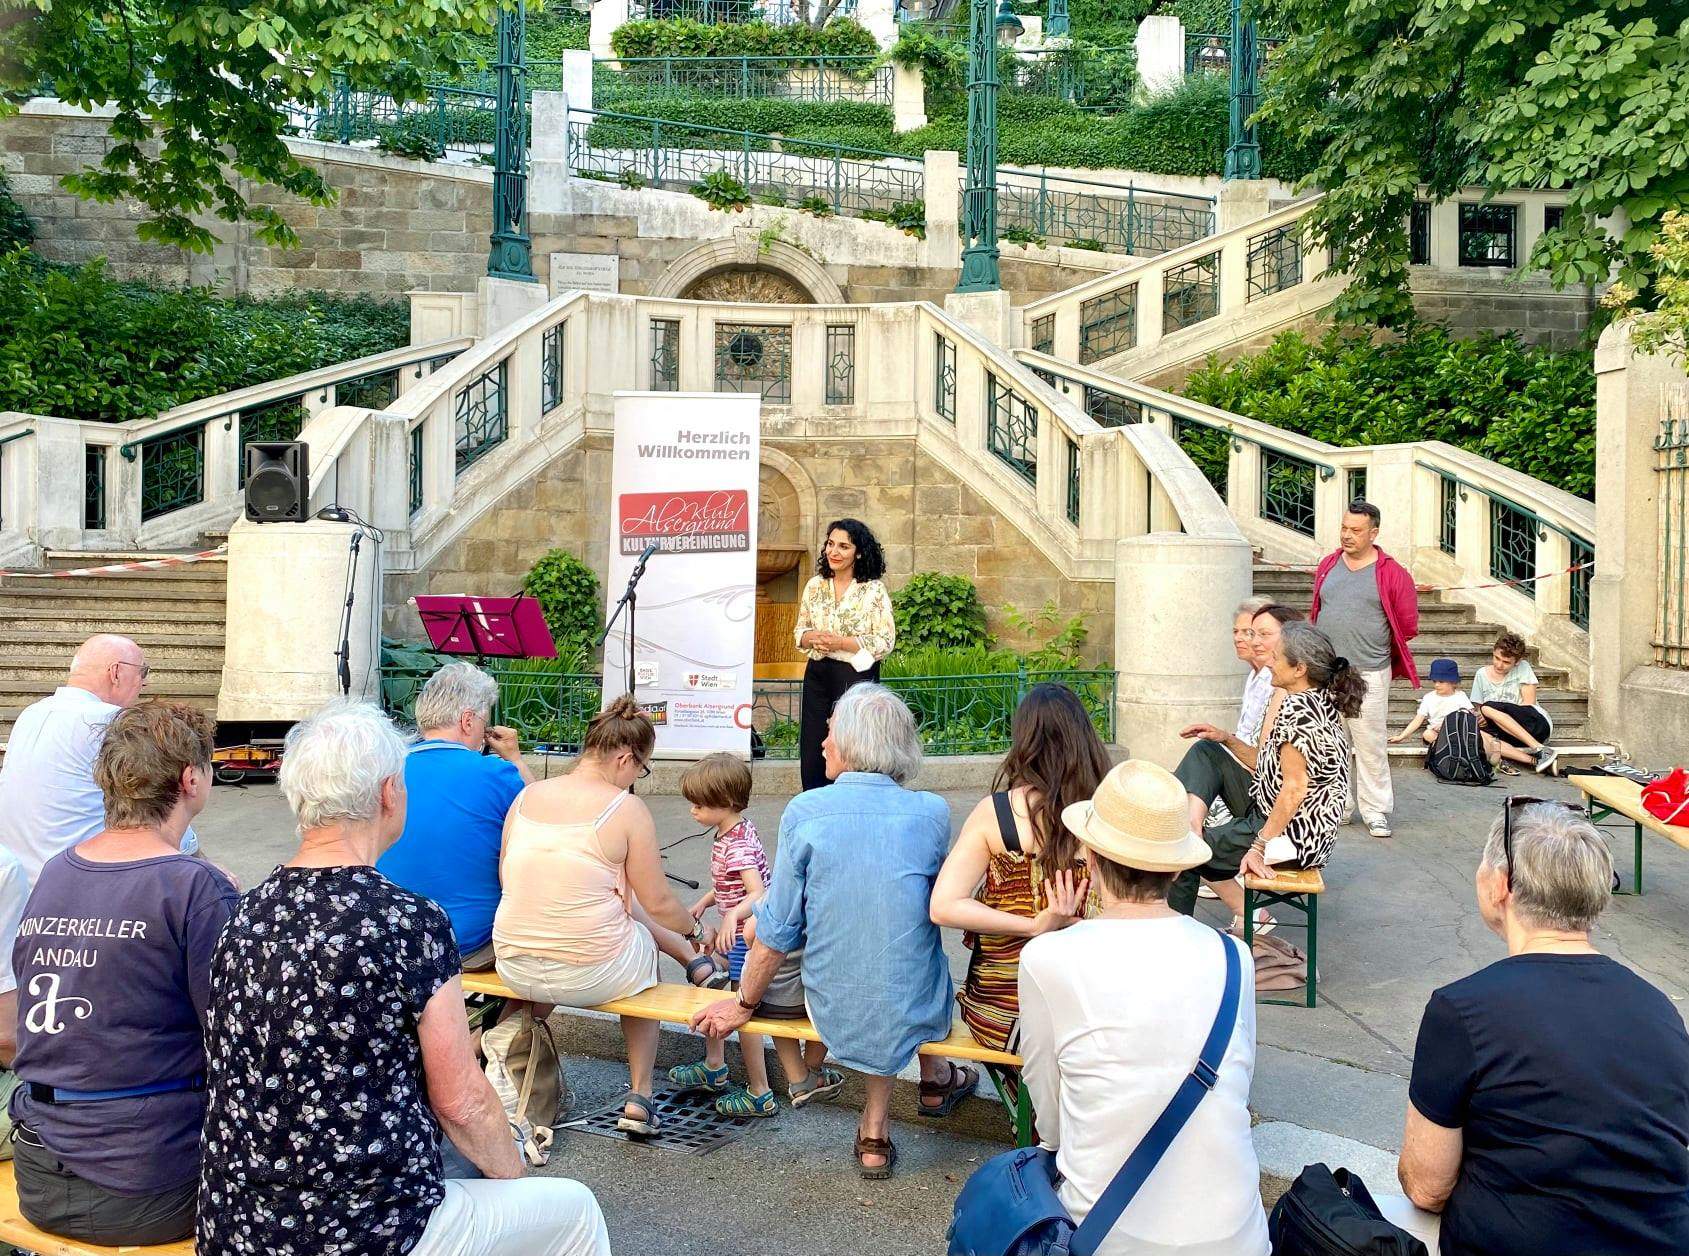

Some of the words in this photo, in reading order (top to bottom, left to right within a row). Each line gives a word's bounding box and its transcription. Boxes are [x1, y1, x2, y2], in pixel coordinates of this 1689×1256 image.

[677, 430, 751, 445] Herzlich
[637, 444, 750, 460] Willkommen
[684, 491, 735, 521] Klub
[32, 947, 98, 968] ANDAU
